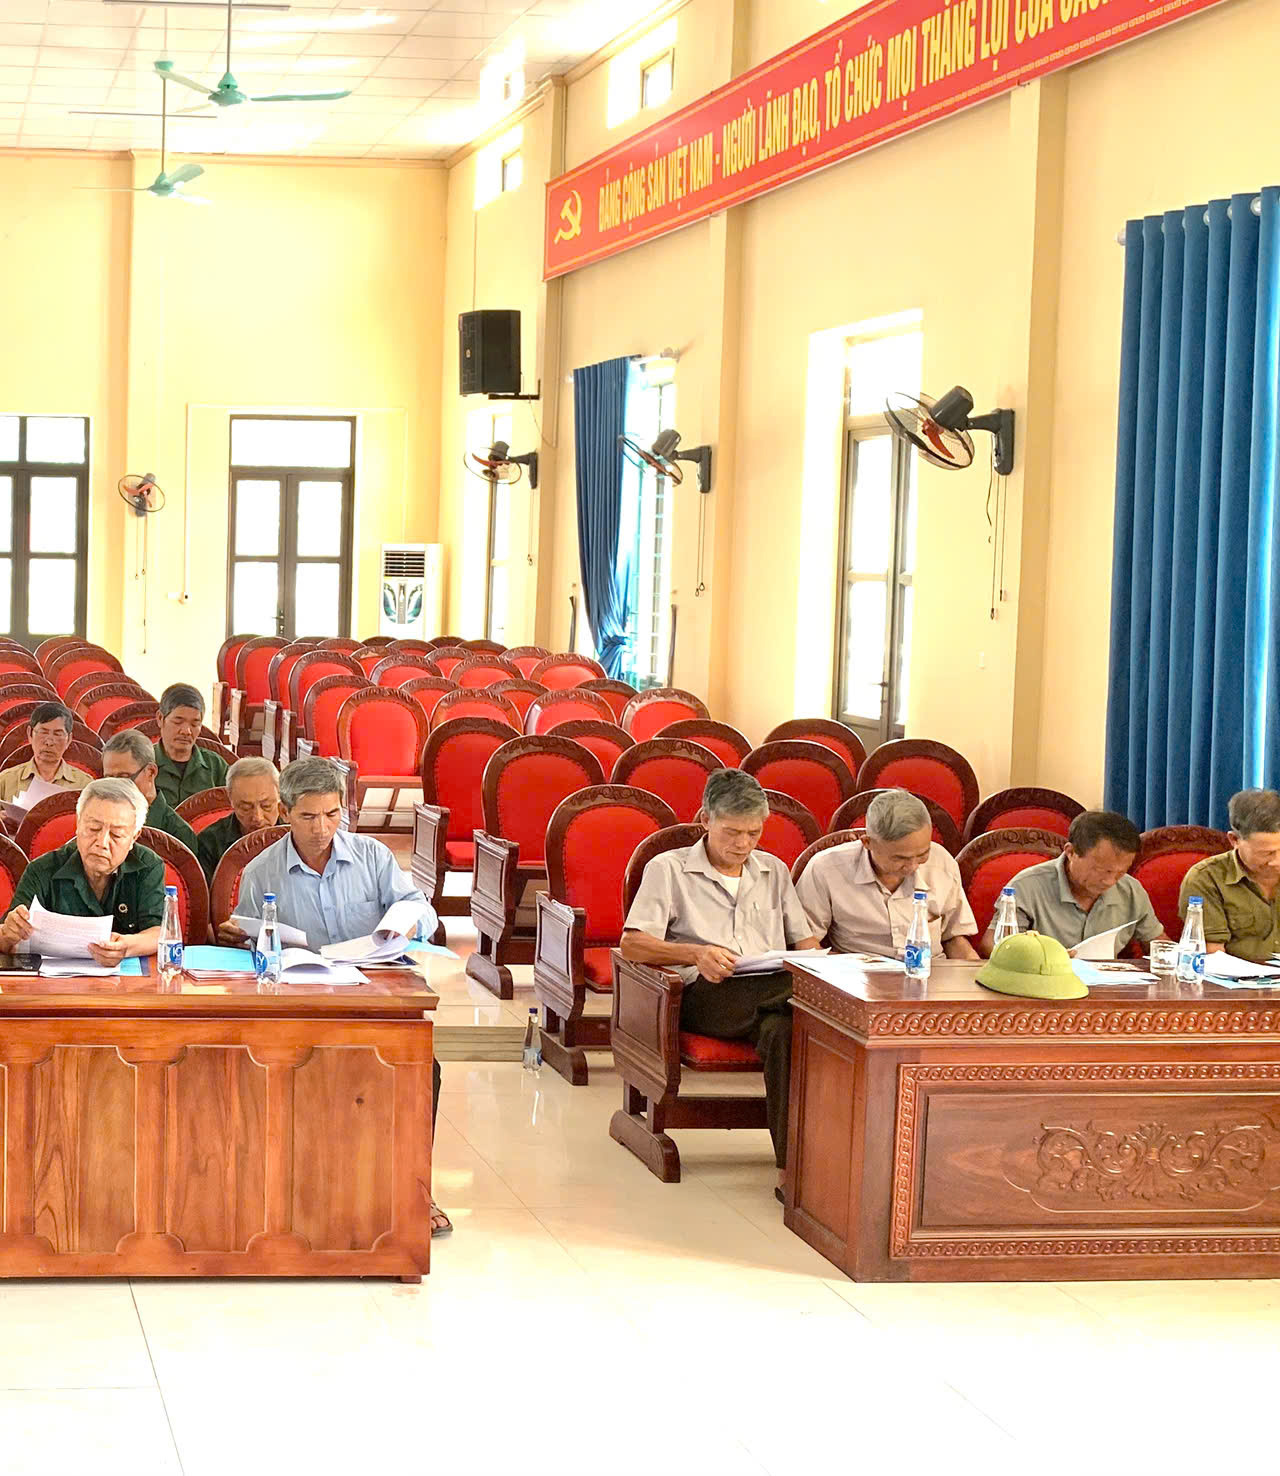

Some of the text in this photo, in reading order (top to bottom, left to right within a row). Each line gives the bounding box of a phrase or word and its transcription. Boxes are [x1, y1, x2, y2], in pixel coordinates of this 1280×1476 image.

[668, 136, 688, 211] VIỆT
[690, 132, 713, 193] NAM
[844, 35, 883, 122] CHỨC
[886, 25, 917, 111] MỌI
